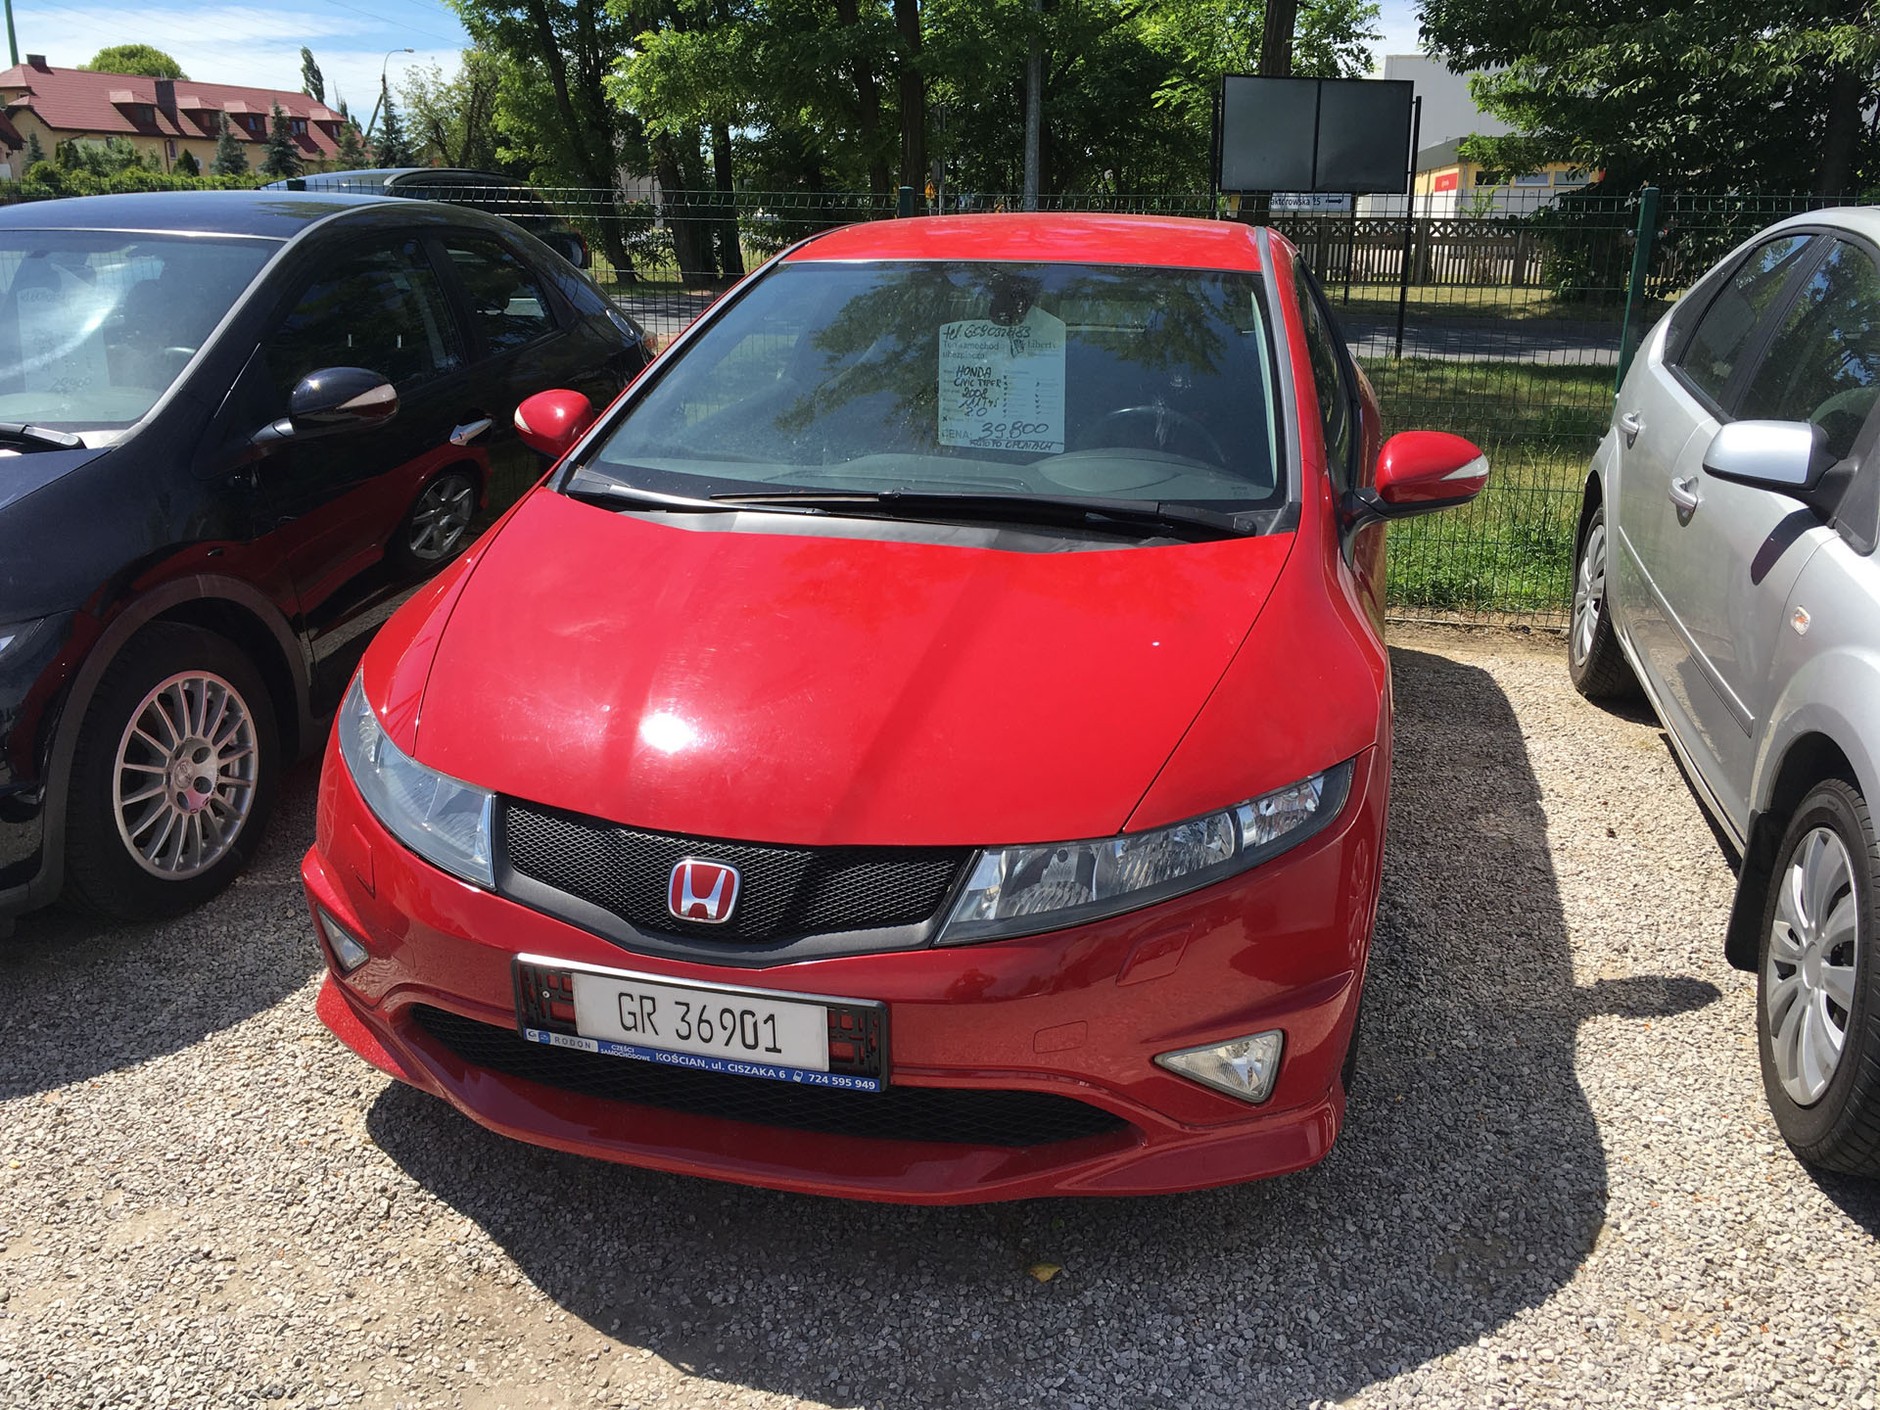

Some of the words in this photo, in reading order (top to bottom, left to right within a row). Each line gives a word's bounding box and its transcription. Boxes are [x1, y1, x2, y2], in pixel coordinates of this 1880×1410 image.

[956, 365, 992, 378] HONDA
[962, 387, 989, 400] 2008
[617, 991, 659, 1037] GR
[674, 1000, 782, 1054] 36901
[553, 1036, 591, 1050] RODON
[600, 1048, 651, 1062] SAMOCHODOWE
[655, 1052, 709, 1069] KOŚCIAN,
[711, 1061, 725, 1071] ul.
[727, 1063, 776, 1078] CISZAKA
[778, 1070, 786, 1079] 6
[808, 1073, 829, 1084] 724
[832, 1076, 852, 1087] 595
[855, 1079, 876, 1090] 949
